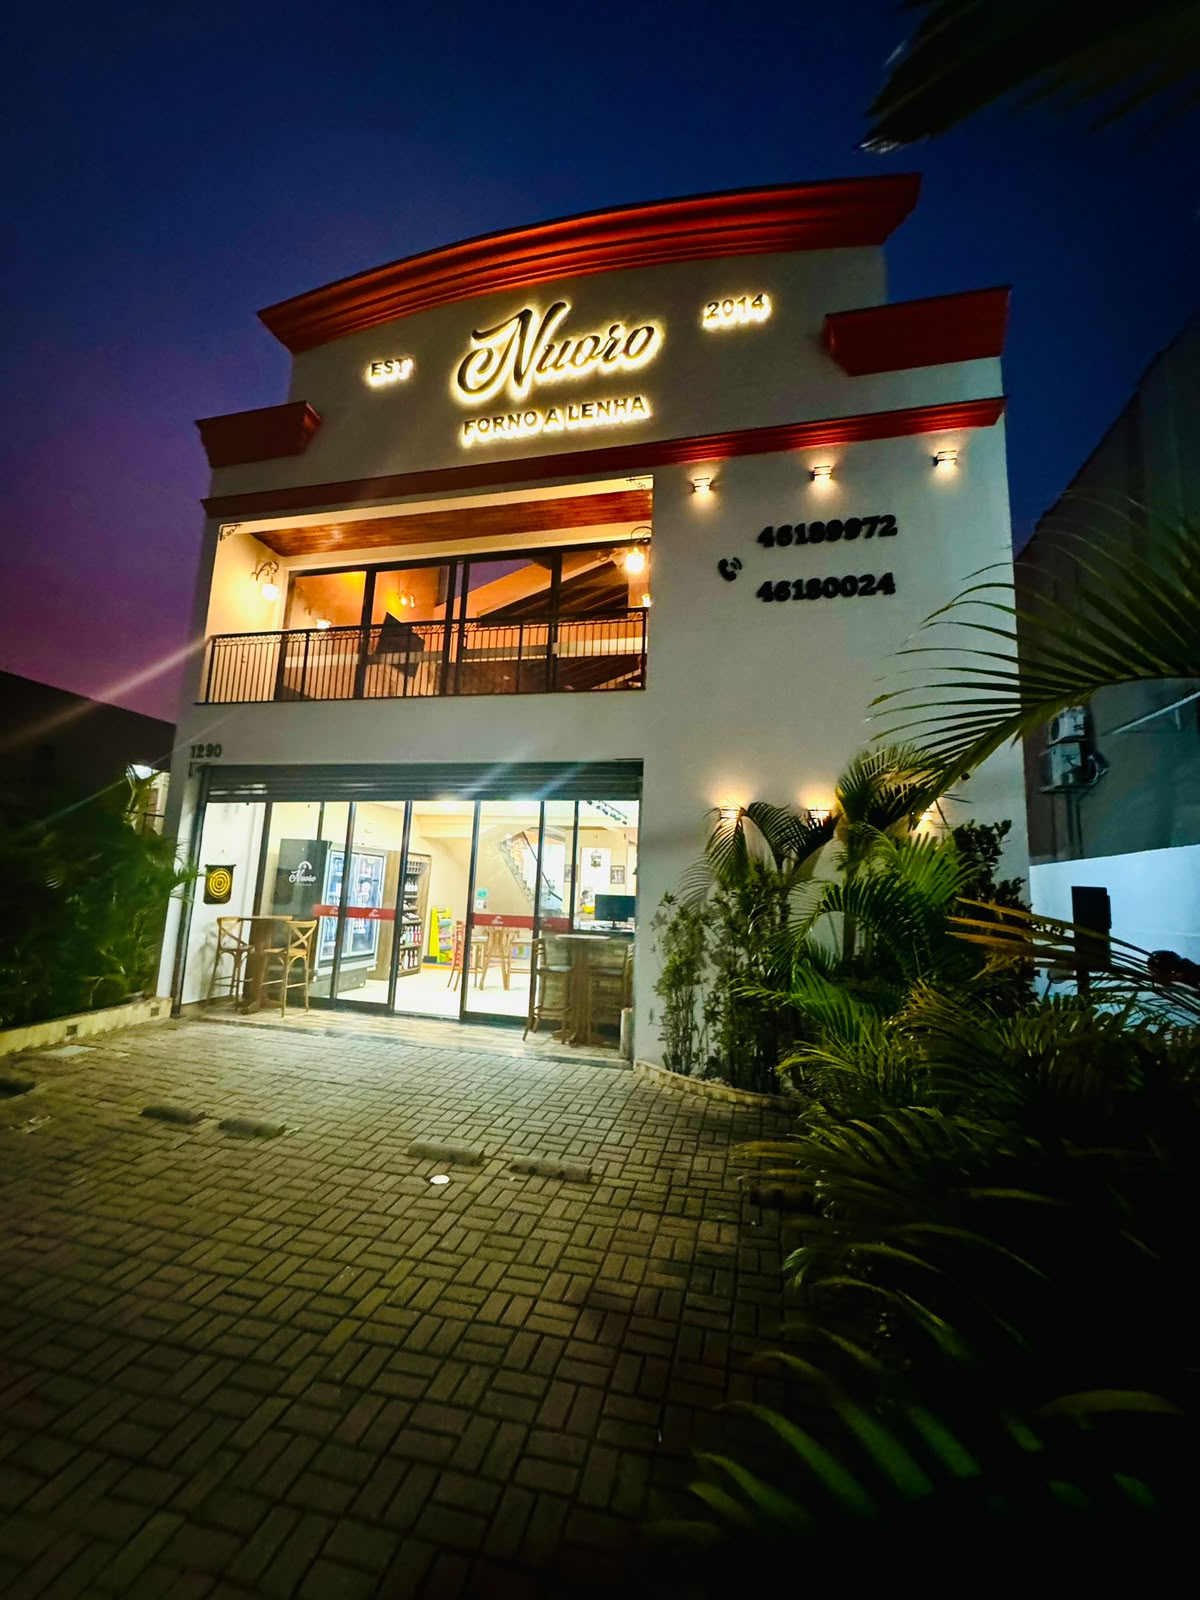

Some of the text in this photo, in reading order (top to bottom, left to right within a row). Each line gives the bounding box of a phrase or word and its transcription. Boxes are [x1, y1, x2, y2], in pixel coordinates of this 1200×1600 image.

[705, 293, 765, 319] 2014
[457, 301, 655, 395] Nuoro
[463, 396, 647, 436] FORNO A LENHA
[756, 514, 898, 548] 46189972
[756, 572, 896, 602] 46180024
